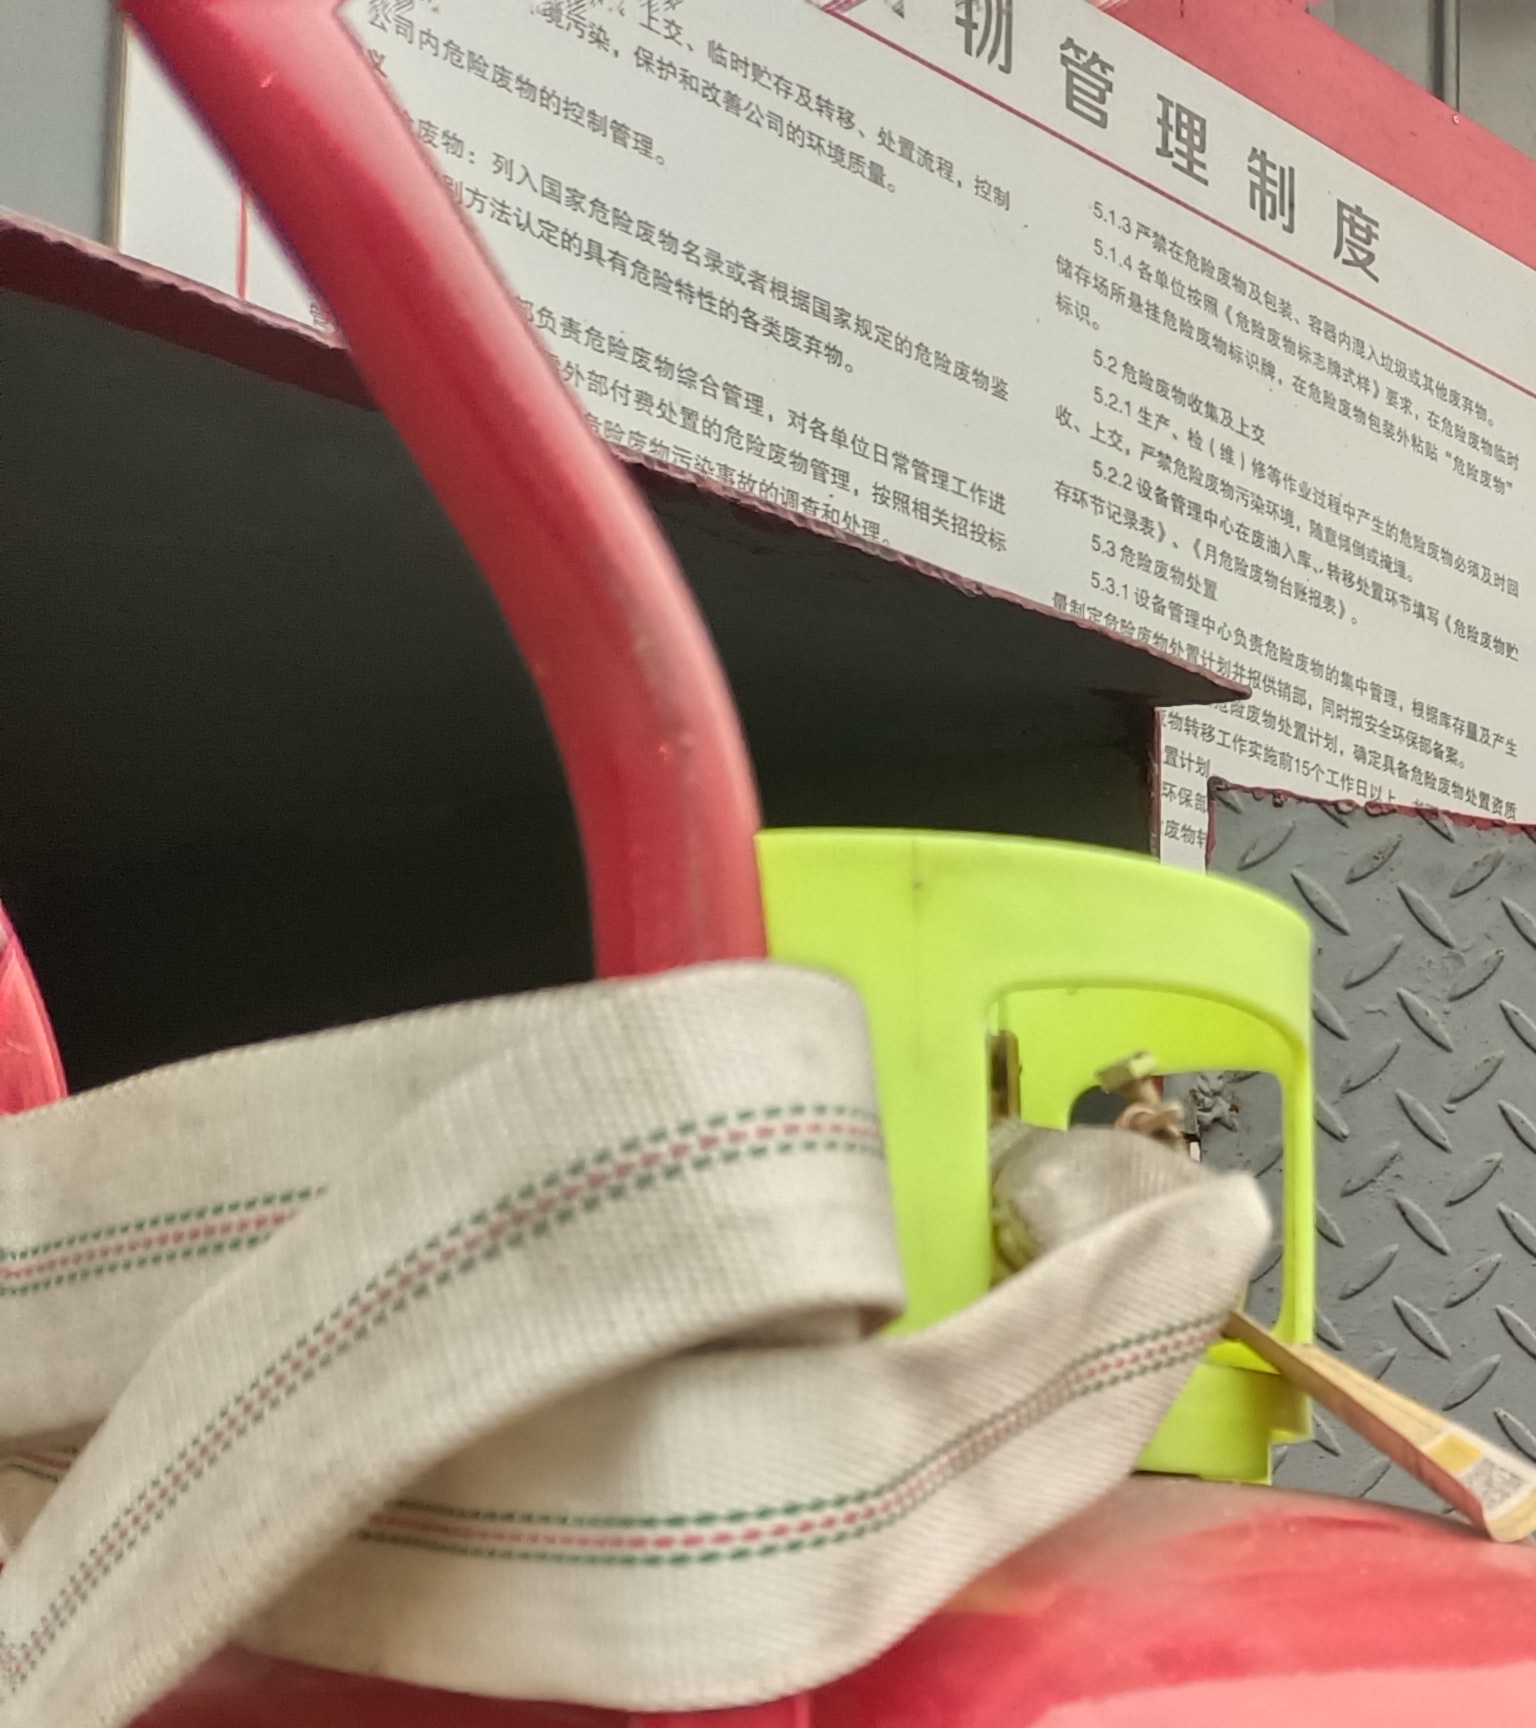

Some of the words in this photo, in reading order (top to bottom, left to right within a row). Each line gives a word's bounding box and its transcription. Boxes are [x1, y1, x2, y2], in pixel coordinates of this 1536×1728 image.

[1093, 201, 1131, 234] 5.1.3
[1094, 238, 1132, 271] 5.1.4
[1055, 292, 1100, 331] 标识。
[1094, 348, 1118, 374] 5.2
[1121, 361, 1266, 446] 危险废物收集及上交
[1094, 386, 1131, 416] 5.2.1
[548, 352, 1007, 552] 外部付费处置的危险废物管理，按照相关招投标
[1092, 459, 1132, 492] 5.2.2
[1091, 533, 1116, 558] 5.3
[1119, 544, 1218, 601] 危险废物处置
[1090, 571, 1128, 600] 5.3.1
